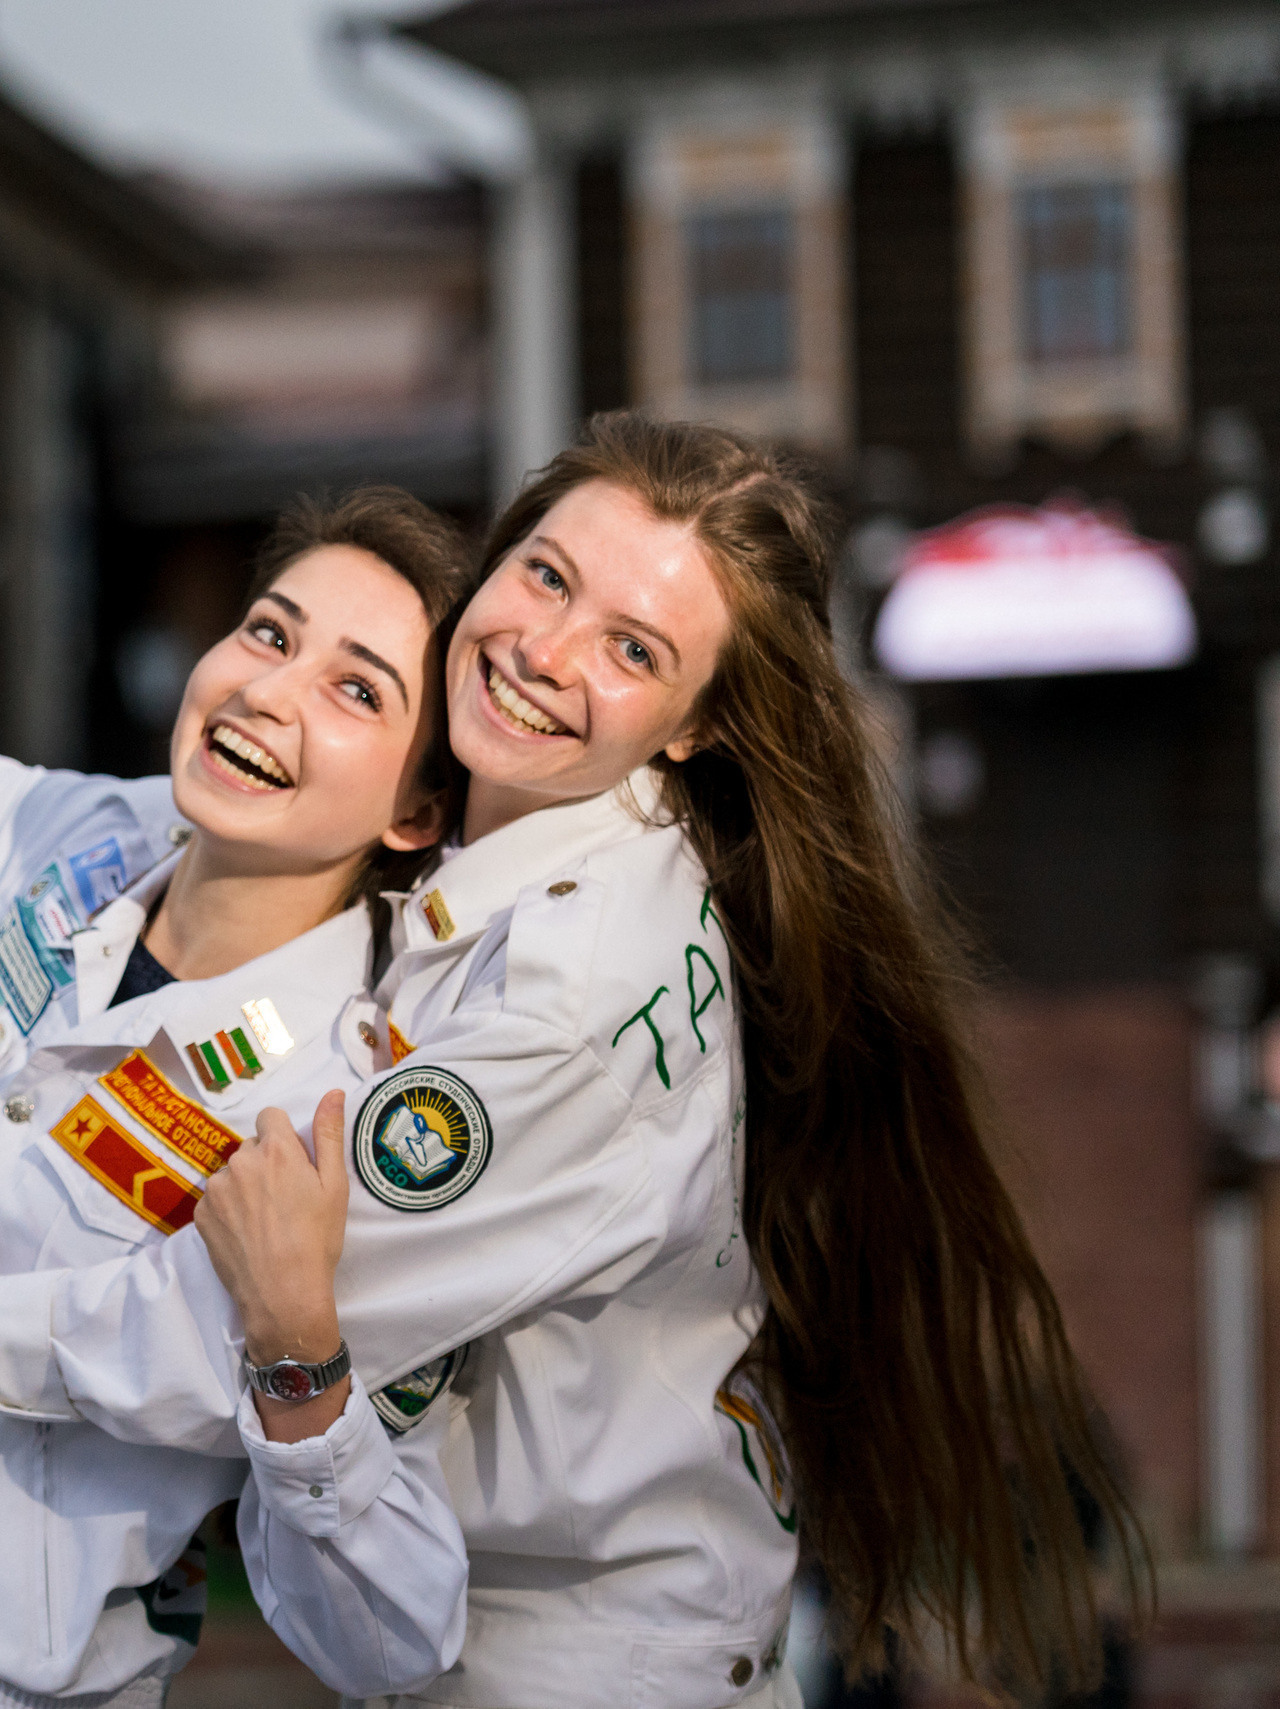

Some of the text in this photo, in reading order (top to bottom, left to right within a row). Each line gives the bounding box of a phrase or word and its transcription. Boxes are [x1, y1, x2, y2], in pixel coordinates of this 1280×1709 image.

[106, 1070, 228, 1172] РЕГИОНАЛЬНОЕ ОТДЕЛЕН
[138, 1072, 231, 1152] ТАТАРСТАНСКОЕ
[384, 1076, 436, 1098] РОССИЙСКИЕ
[438, 1080, 481, 1134] СТУДЕНЧЕСКИЕ
[465, 1138, 481, 1174] ОТРЯДЫ
[376, 1155, 409, 1188] РСО
